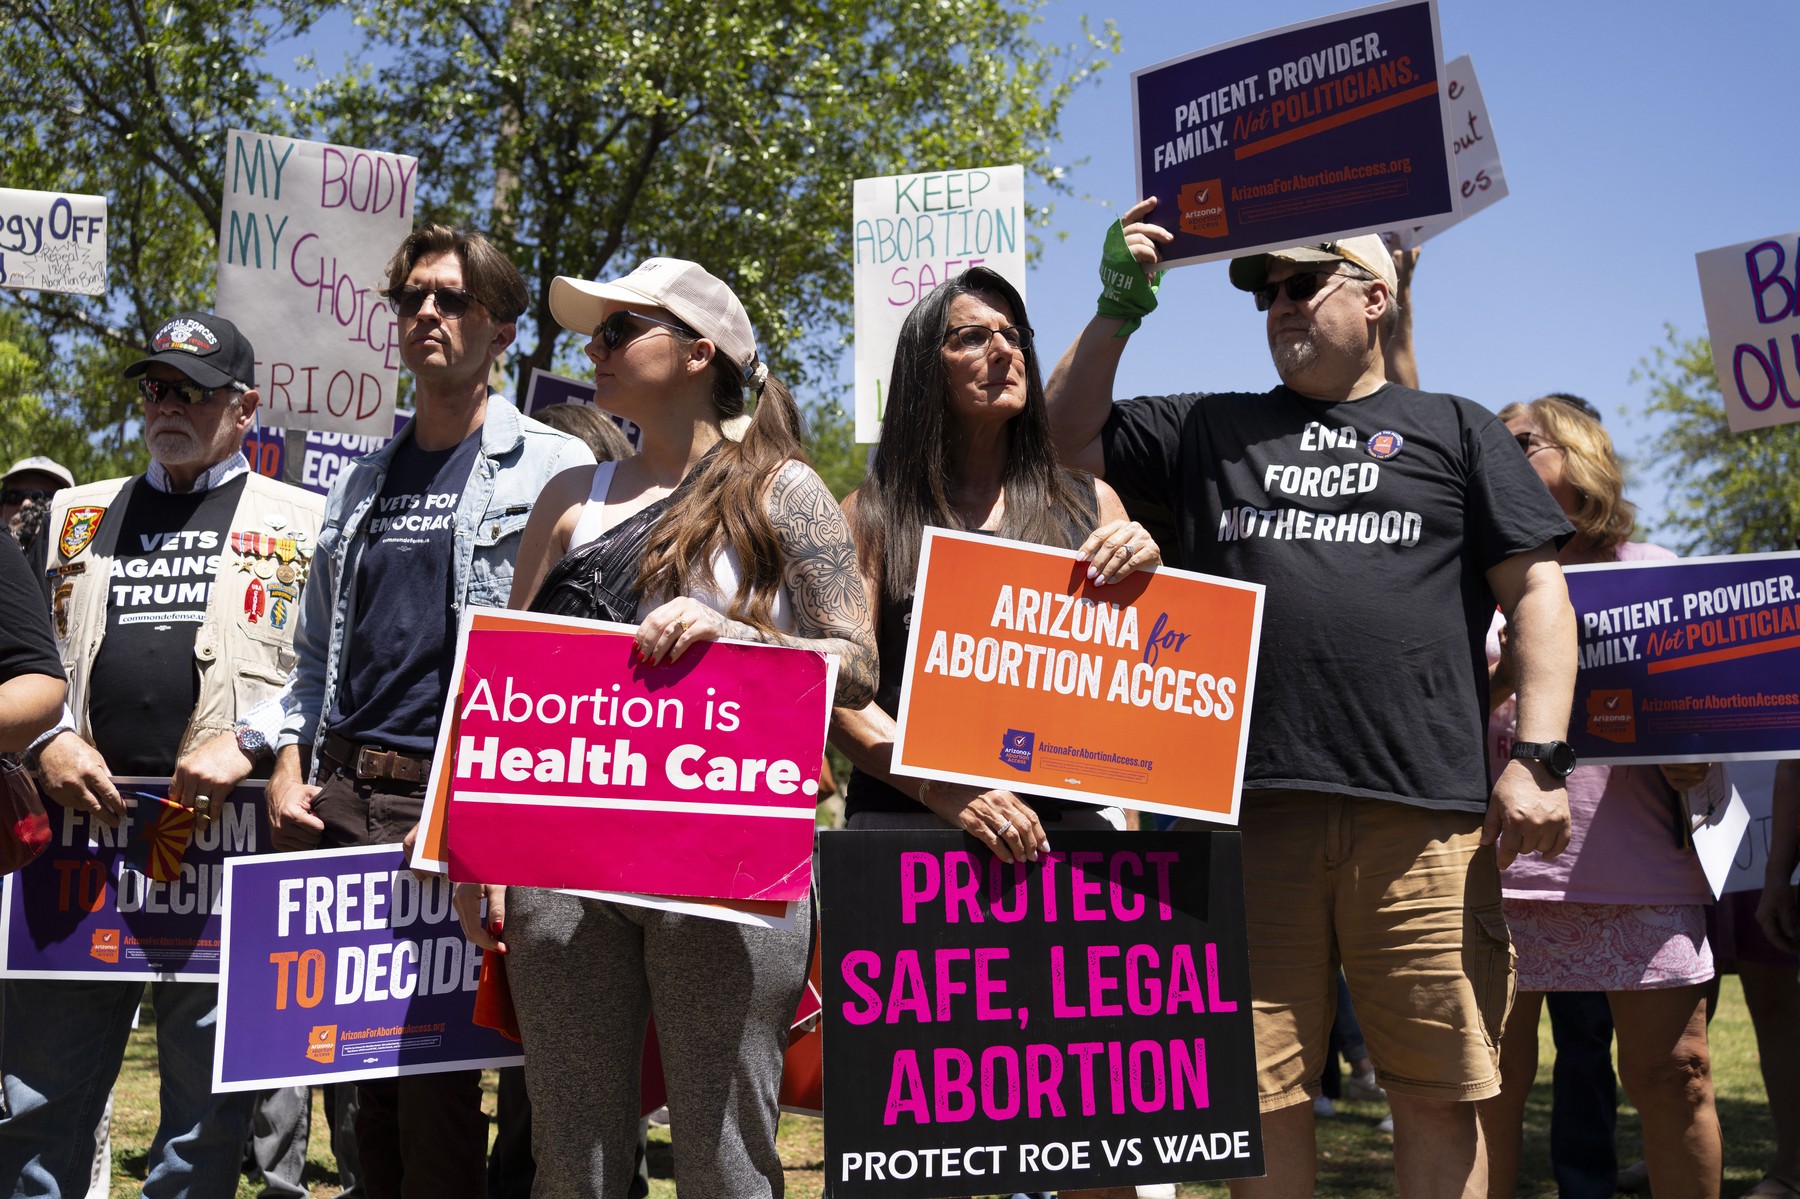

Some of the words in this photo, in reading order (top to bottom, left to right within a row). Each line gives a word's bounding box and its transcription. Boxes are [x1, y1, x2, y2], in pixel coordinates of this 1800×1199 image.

[1175, 75, 1264, 132] PATIENT.
[1268, 32, 1388, 96] PROVIDER.
[1154, 121, 1228, 173] FAMILY.
[1233, 108, 1272, 140] Not
[1272, 55, 1419, 129] POLITICIANS.
[233, 136, 294, 200] MY
[321, 148, 418, 218] BODY
[895, 170, 991, 214] KEEP
[1231, 157, 1412, 202] ArizonaForAbortionAccess.org
[48, 197, 103, 244] OFF
[856, 206, 1015, 264] ABORTION
[1185, 208, 1217, 219] Arizona
[1188, 213, 1221, 225] Abortion
[228, 210, 288, 270] MY
[291, 233, 400, 370] CHOICE
[155, 318, 185, 340] SPECIAL
[187, 319, 217, 345] FORCES
[1300, 421, 1358, 451] END
[246, 440, 280, 479] TO
[1264, 462, 1380, 498] FORCED
[379, 494, 420, 513] VETS
[140, 530, 219, 552] VETS
[1217, 507, 1423, 548] MOTHERHOOD
[110, 555, 221, 578] AGAINS
[990, 584, 1140, 650] ARIZONA
[1143, 611, 1192, 668] for
[1584, 597, 1679, 638] PATIENT.
[1683, 575, 1800, 619] PROVIDER.
[1578, 635, 1641, 670] AMILY.
[1647, 629, 1684, 657] Not
[924, 629, 1103, 700] ABORTION
[1106, 659, 1237, 721] ACCESS
[460, 677, 684, 730] Abortion
[704, 687, 741, 732] is
[1641, 692, 1800, 712] ArizonaForAbortionAccess
[455, 735, 648, 788] Health
[665, 743, 819, 796] Care.
[1004, 747, 1027, 756] Arizona
[1005, 752, 1030, 761] Abortion
[1007, 757, 1027, 765] Access
[1038, 741, 1153, 770] ArizonaForAbortionAccess.org
[53, 860, 107, 913] TO
[900, 850, 1180, 925] PROTECT
[269, 949, 326, 1010] TO
[841, 947, 1029, 1030] SAFE,
[1051, 942, 1238, 1019] LEGAL
[340, 1022, 446, 1041] ArizonaForAbortionAccess.org
[883, 1037, 1210, 1126] ABORTION
[841, 1145, 1007, 1182] PROTECT
[1019, 1140, 1091, 1172] ROE
[1101, 1137, 1143, 1167] VS
[1153, 1130, 1251, 1164] WADE
